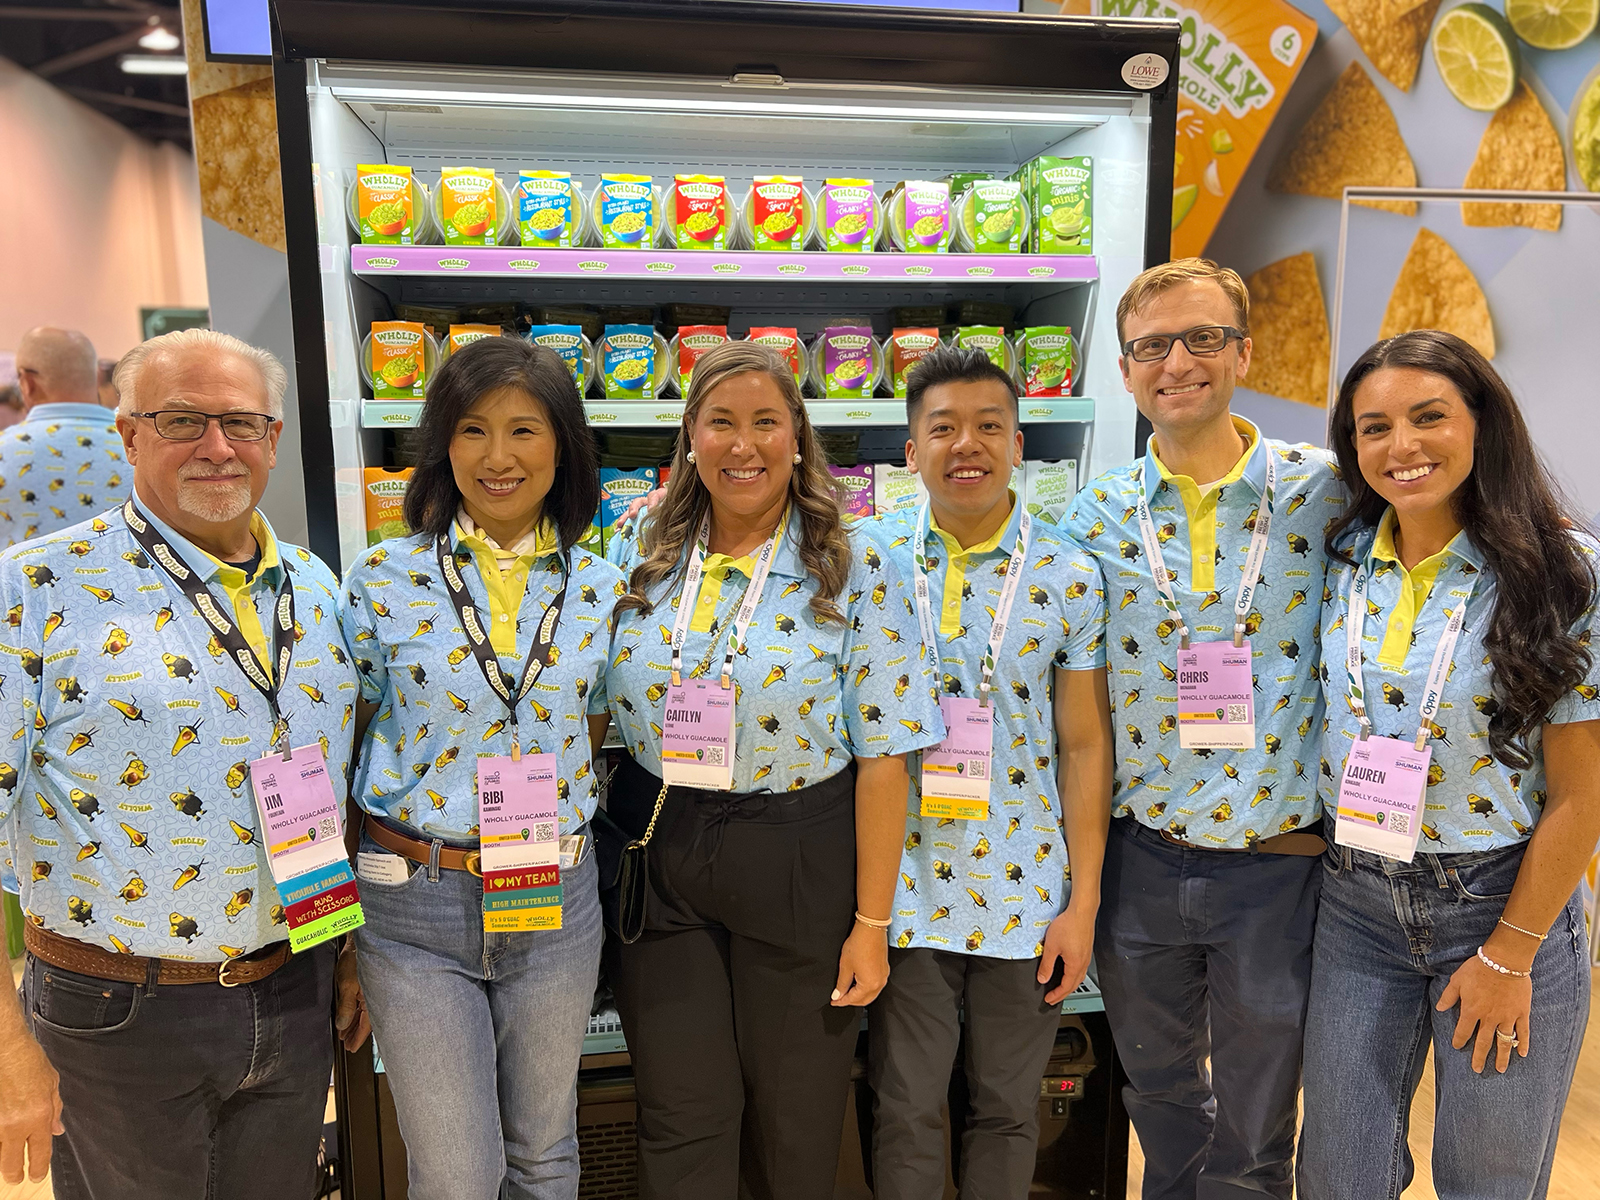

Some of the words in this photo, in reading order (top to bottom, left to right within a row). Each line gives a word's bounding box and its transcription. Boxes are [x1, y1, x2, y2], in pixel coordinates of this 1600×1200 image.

[1281, 33, 1296, 50] 6
[1131, 66, 1160, 77] LOWE
[1046, 168, 1088, 180] WHOLLY
[362, 175, 407, 186] WHOLLY
[446, 177, 491, 188] WHOLLY
[524, 180, 566, 192] WHOLLY
[607, 185, 647, 196] WHOLLY
[681, 184, 720, 196] WHOLLY
[759, 185, 798, 196] WHOLLY
[831, 188, 869, 199] WHOLLY
[910, 191, 946, 200] WHOLLY
[979, 188, 1018, 198] WHOLLY
[374, 193, 395, 202] CLASSIC
[458, 194, 479, 204] CLASSIC
[1051, 193, 1079, 206] minis
[691, 202, 708, 211] SPICY
[769, 202, 786, 212] SPICY
[368, 258, 398, 266] WHOLLY
[439, 259, 469, 268] WHOLLY
[510, 260, 539, 269] WHOLLY
[578, 262, 607, 270] WHOLLY
[646, 262, 675, 271] WHOLLY
[713, 264, 741, 272] WHOLLY
[778, 264, 806, 272] WHOLLY
[842, 266, 870, 274] WHOLLY
[906, 266, 932, 274] WHOLLY
[968, 266, 994, 274] WHOLLY
[1029, 267, 1055, 275] WHOLLY
[376, 331, 420, 342] WHOLLY
[536, 334, 579, 345] WHOLLY
[609, 335, 650, 345] WHOLLY
[684, 336, 724, 346] WHOLLY
[830, 336, 868, 346] WHOLLY
[897, 336, 936, 346] WHOLLY
[963, 337, 1000, 346] WHOLLY
[1030, 336, 1068, 346] WHOLLY
[386, 348, 408, 357] CLASSIC
[382, 414, 412, 422] WHOLLY
[1038, 466, 1065, 474] WHOLLY
[605, 480, 652, 492] WHOLLY
[884, 478, 917, 492] SMASHED
[1035, 474, 1068, 489] SMASHED
[885, 486, 917, 500] AVOCADO
[1036, 482, 1068, 496] AVOCADO
[893, 500, 916, 511] minis
[1044, 496, 1066, 506] minis
[761, 544, 773, 562] Oppy
[155, 545, 188, 578] WHOLLY
[1010, 556, 1022, 578] Oppy
[444, 556, 462, 592] WHOLLY
[1285, 570, 1310, 578] WHOLLY
[1355, 574, 1366, 595] Oppy
[1240, 585, 1252, 609] Oppy
[409, 600, 438, 608] WHOLLY
[196, 594, 230, 634] WHOLLY
[278, 595, 292, 630] WHOLLY
[464, 607, 486, 644] WHOLLY
[541, 607, 558, 643] WHOLLY
[674, 628, 683, 649] Oppy
[767, 646, 792, 654] WHOLLY
[45, 649, 79, 664] WHOLLY
[928, 645, 937, 667] Oppy
[238, 650, 270, 689] WHOLLY
[106, 671, 142, 682] WHOLLY
[487, 661, 510, 699] WHOLLY
[1180, 670, 1209, 684] CHRIS
[168, 700, 200, 709] WHOLLY
[1422, 690, 1438, 714] Oppy
[666, 709, 702, 724] CAITLYN
[221, 736, 250, 745] WHOLLY
[690, 735, 728, 744] GUACAMOLE
[952, 748, 990, 756] GUACAMOLE
[1395, 761, 1422, 772] SHUMAN
[301, 768, 324, 778] SHUMAN
[527, 774, 553, 782] SHUMAN
[1346, 764, 1386, 784] LAUREN
[264, 793, 283, 811] JIM
[483, 790, 504, 805] BIBI
[1343, 790, 1372, 801] WHOLLY
[1372, 796, 1416, 812] GUACAMOLE
[119, 803, 152, 812] WHOLLY
[271, 816, 298, 830] WHOLLY
[299, 804, 338, 822] GUACAMOLE
[484, 815, 514, 824] WHOLLY
[515, 811, 558, 821] GUACAMOLE
[171, 838, 207, 846] WHOLLY
[273, 849, 290, 858] BOOTH
[225, 864, 258, 875] WHOLLY
[73, 874, 100, 887] WHOLLY
[490, 879, 493, 890] I
[506, 876, 522, 888] MY
[526, 871, 556, 885] TEAM
[286, 883, 320, 903] TROUBLE
[320, 872, 348, 888] MAKER
[314, 894, 333, 908] RUNS
[492, 900, 510, 909] HIGH
[510, 896, 560, 908] MAINTENANCE
[296, 910, 317, 924] WITH
[317, 894, 354, 914] SCISSORS
[115, 916, 146, 928] WHOLLY
[331, 914, 358, 928] WHOLLY
[296, 927, 328, 945] GUACAHOLIC
[1060, 1080, 1074, 1091] 37
